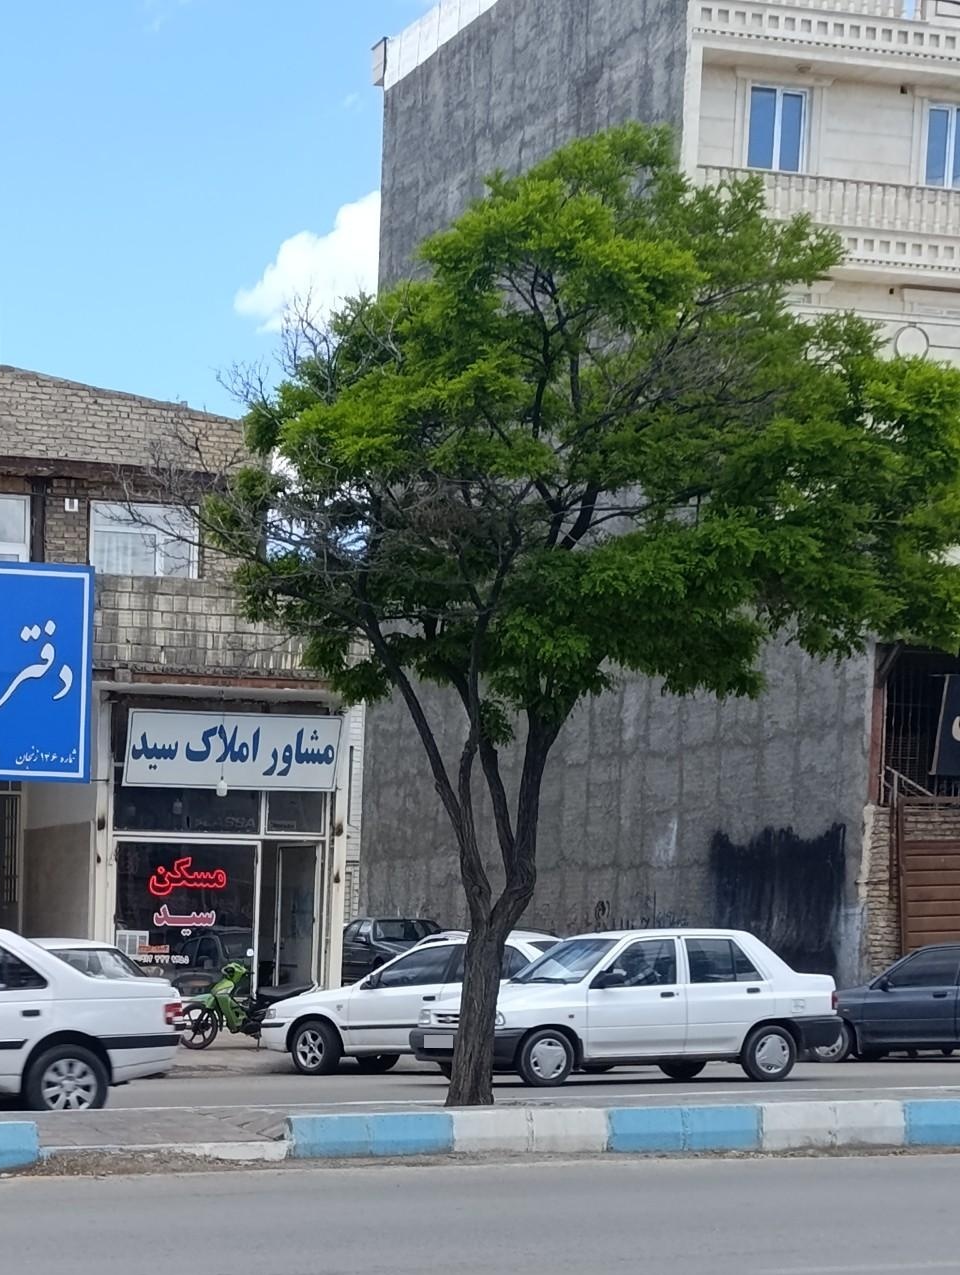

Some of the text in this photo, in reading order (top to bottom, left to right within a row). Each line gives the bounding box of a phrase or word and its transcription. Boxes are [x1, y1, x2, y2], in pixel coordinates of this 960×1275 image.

[131, 724, 335, 777] مشاور املاک سید
[149, 856, 227, 896] مسکن
[153, 903, 216, 936] سید
